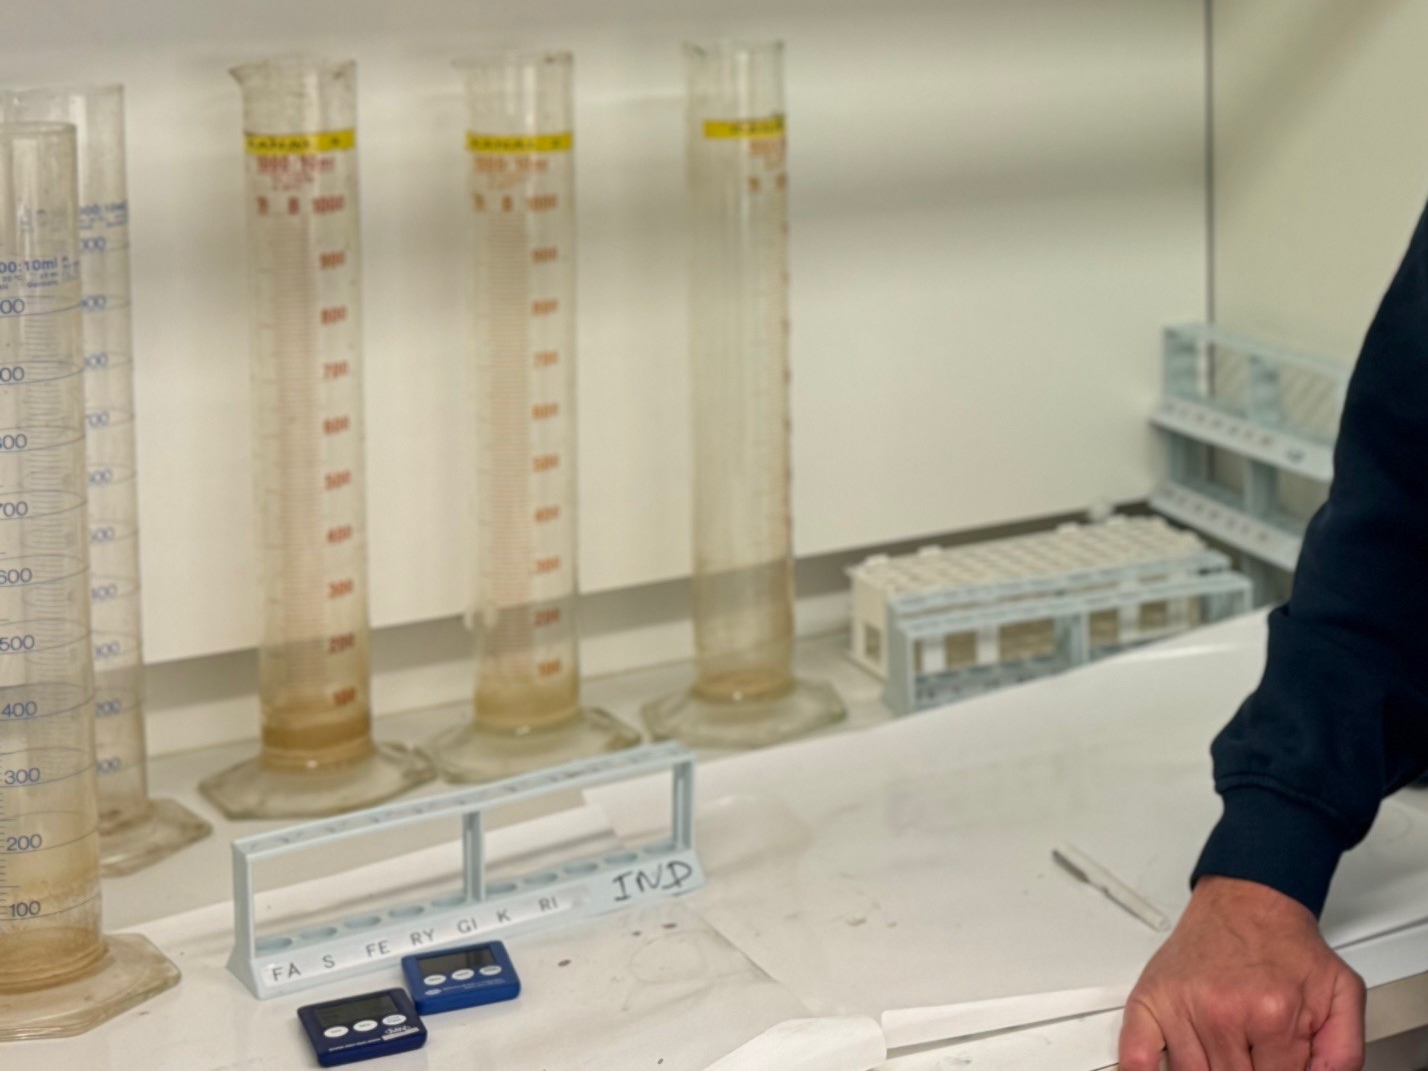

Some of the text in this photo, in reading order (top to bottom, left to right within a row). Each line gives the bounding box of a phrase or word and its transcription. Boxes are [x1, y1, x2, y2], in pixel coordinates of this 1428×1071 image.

[0, 433, 28, 449] 00
[0, 634, 35, 651] 500
[1, 700, 38, 718] 400
[4, 767, 41, 785] 300
[5, 834, 42, 851] 200
[611, 859, 694, 901] IND
[9, 900, 42, 917] 100
[272, 896, 558, 981] FA S FE RY GI K RI
